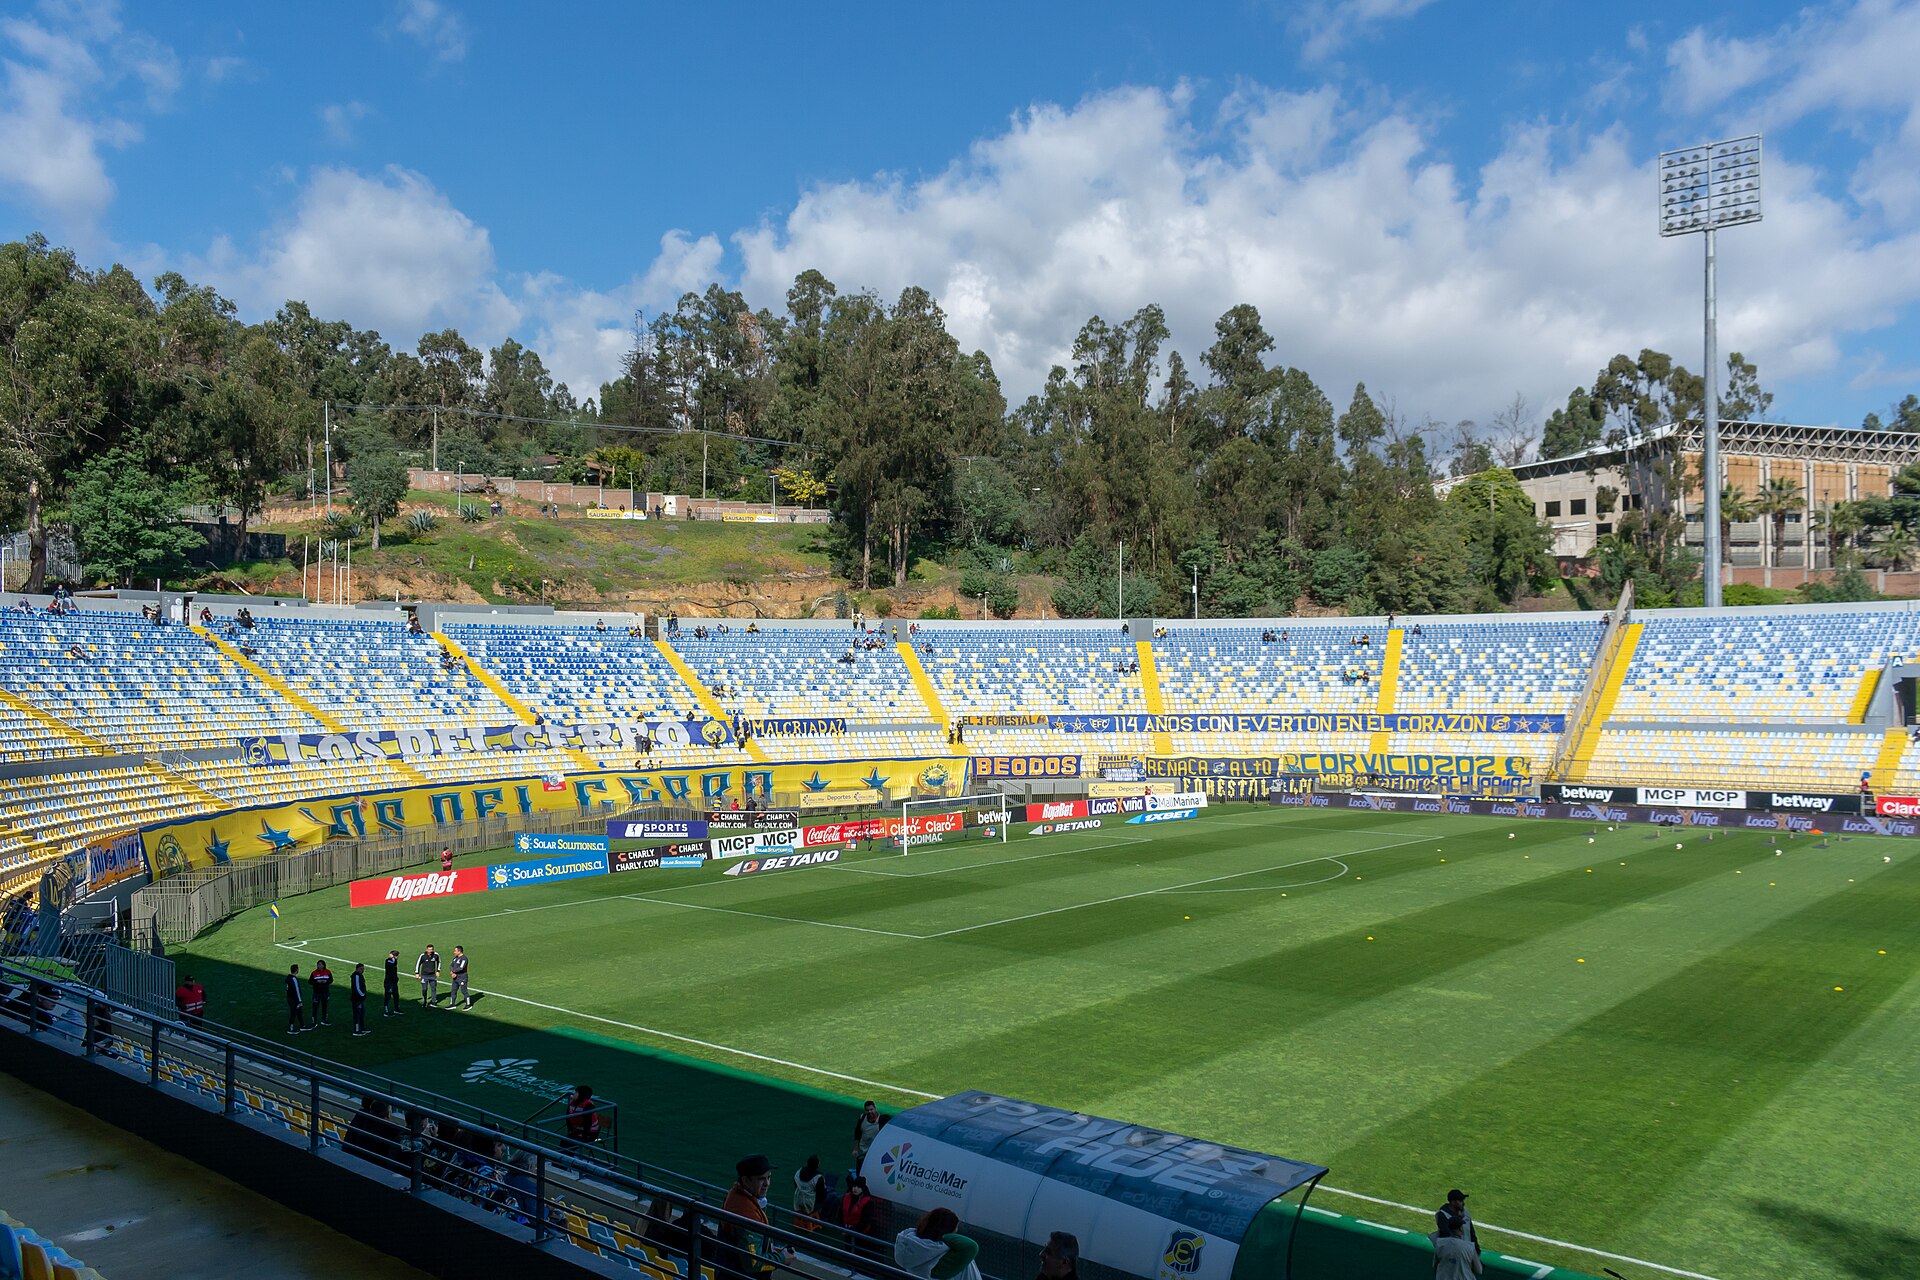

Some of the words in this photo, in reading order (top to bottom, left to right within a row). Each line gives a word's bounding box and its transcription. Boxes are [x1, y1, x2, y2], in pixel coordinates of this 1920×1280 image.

[986, 715, 1036, 727] FORESTAL
[1114, 715, 1138, 732] 114
[1144, 713, 1194, 733] AÑOS
[1197, 715, 1234, 733] CON
[1238, 715, 1332, 733] EVERTON
[1336, 716, 1363, 732] EN
[1366, 716, 1393, 732] EL
[1397, 713, 1488, 733] CORAZÓN
[281, 731, 388, 763] LOS
[394, 727, 503, 758] DEL
[511, 722, 691, 751] CERRO
[977, 756, 1077, 776] BEODOS
[1147, 758, 1208, 777] REÑACA
[1561, 785, 1614, 802] betway
[1645, 789, 1686, 800] MCP
[1695, 791, 1739, 803] MCP
[1772, 793, 1834, 811] betway
[720, 813, 745, 821] CHARLY
[766, 813, 790, 821] CHARLY
[977, 810, 1012, 824] betway
[1042, 802, 1075, 820] RojaBet
[1144, 809, 1194, 822] 1XBET
[643, 823, 689, 832] SPORTS
[708, 821, 747, 829] CHARLY.COM
[1055, 819, 1101, 832] BETANO
[533, 838, 557, 850] SOLAR
[557, 839, 607, 851] SOLUTIONS.CL
[718, 836, 755, 852] MCP
[763, 831, 798, 846] MCP
[905, 833, 943, 845] SODIMAC
[628, 848, 655, 860] CHARLY
[679, 843, 704, 853] CHARLY
[616, 859, 659, 872] CHARLY.COM
[761, 849, 841, 871] BETANO
[513, 866, 545, 881] SOLAR
[545, 860, 605, 877] SOLUTIONS.CL
[385, 871, 459, 902] RojaBet
[897, 1173, 924, 1188] Municipio
[925, 1182, 933, 1190] de
[934, 1184, 962, 1199] Cuidados
[1185, 1207, 1251, 1226] POWER
